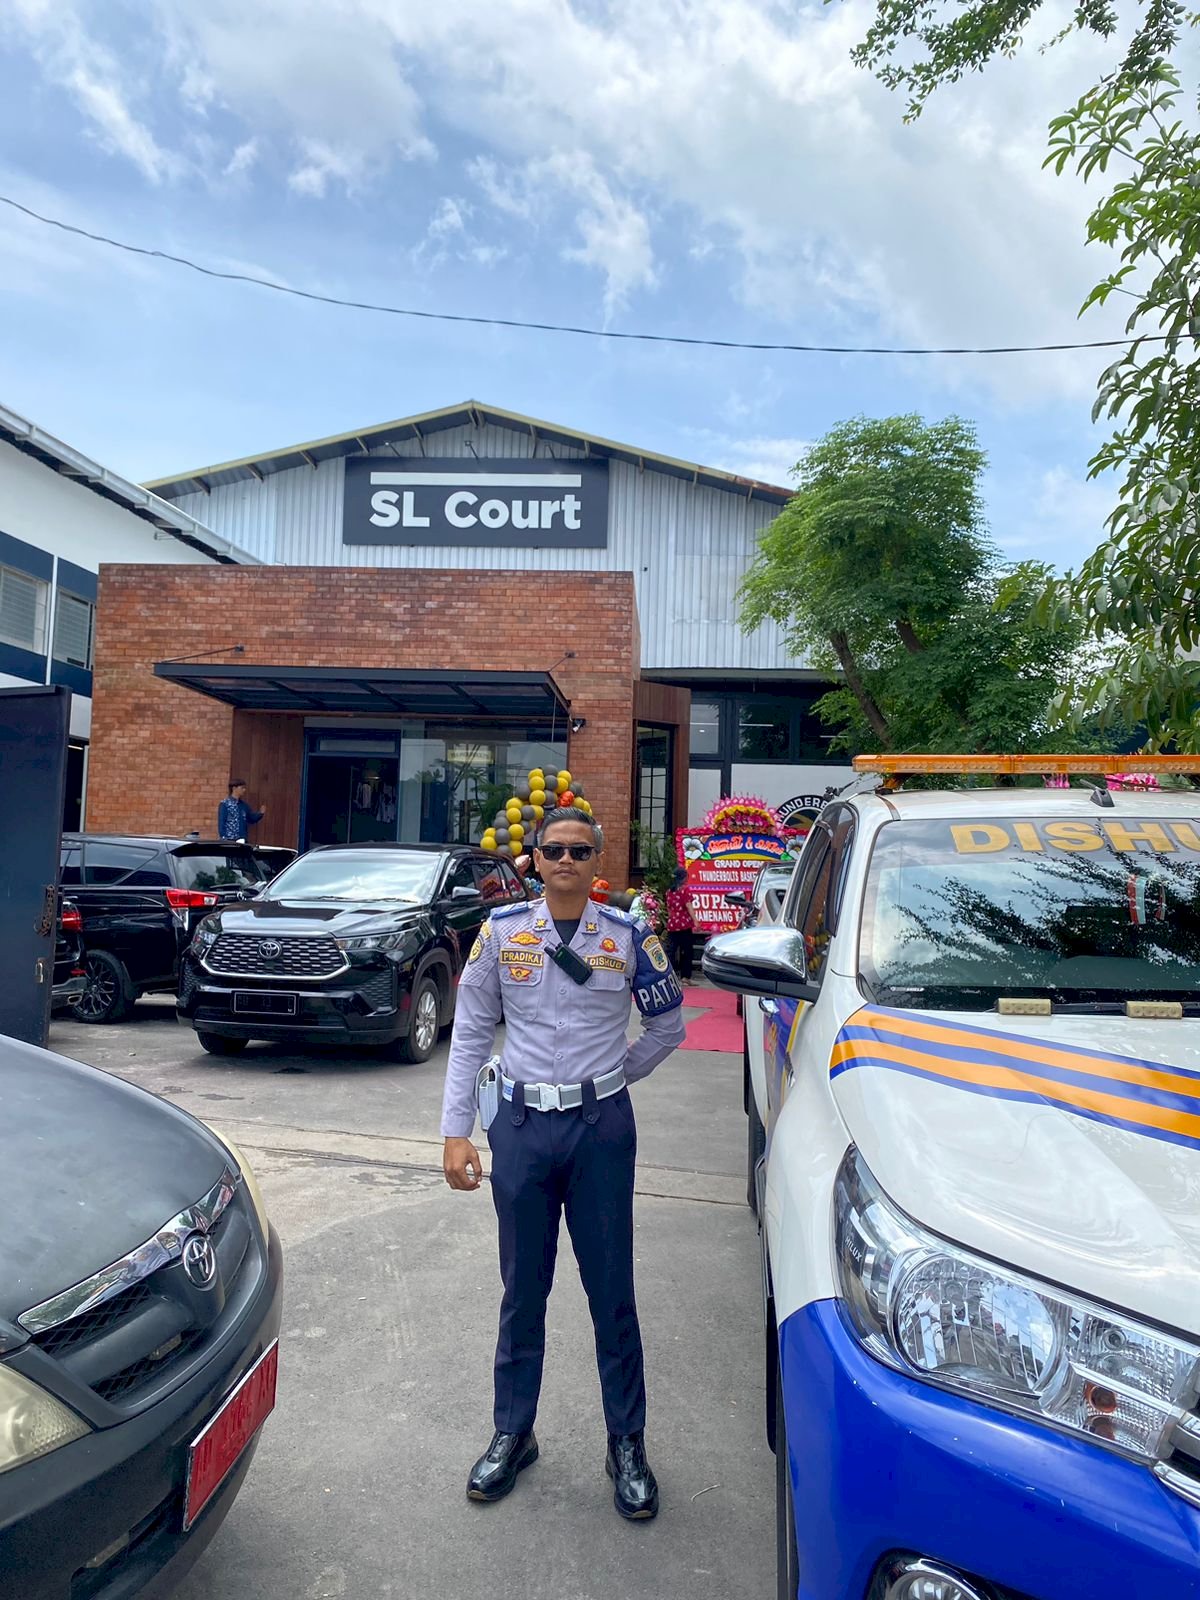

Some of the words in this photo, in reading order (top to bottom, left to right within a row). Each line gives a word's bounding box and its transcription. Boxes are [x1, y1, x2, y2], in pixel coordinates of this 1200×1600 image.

[369, 490, 430, 527] SL
[444, 491, 581, 529] Court
[714, 860, 740, 868] GRAND
[692, 893, 742, 909] BUPA
[503, 952, 539, 963] PRADIKA
[638, 970, 682, 1011] PATR
[845, 1236, 862, 1262] HILUX
